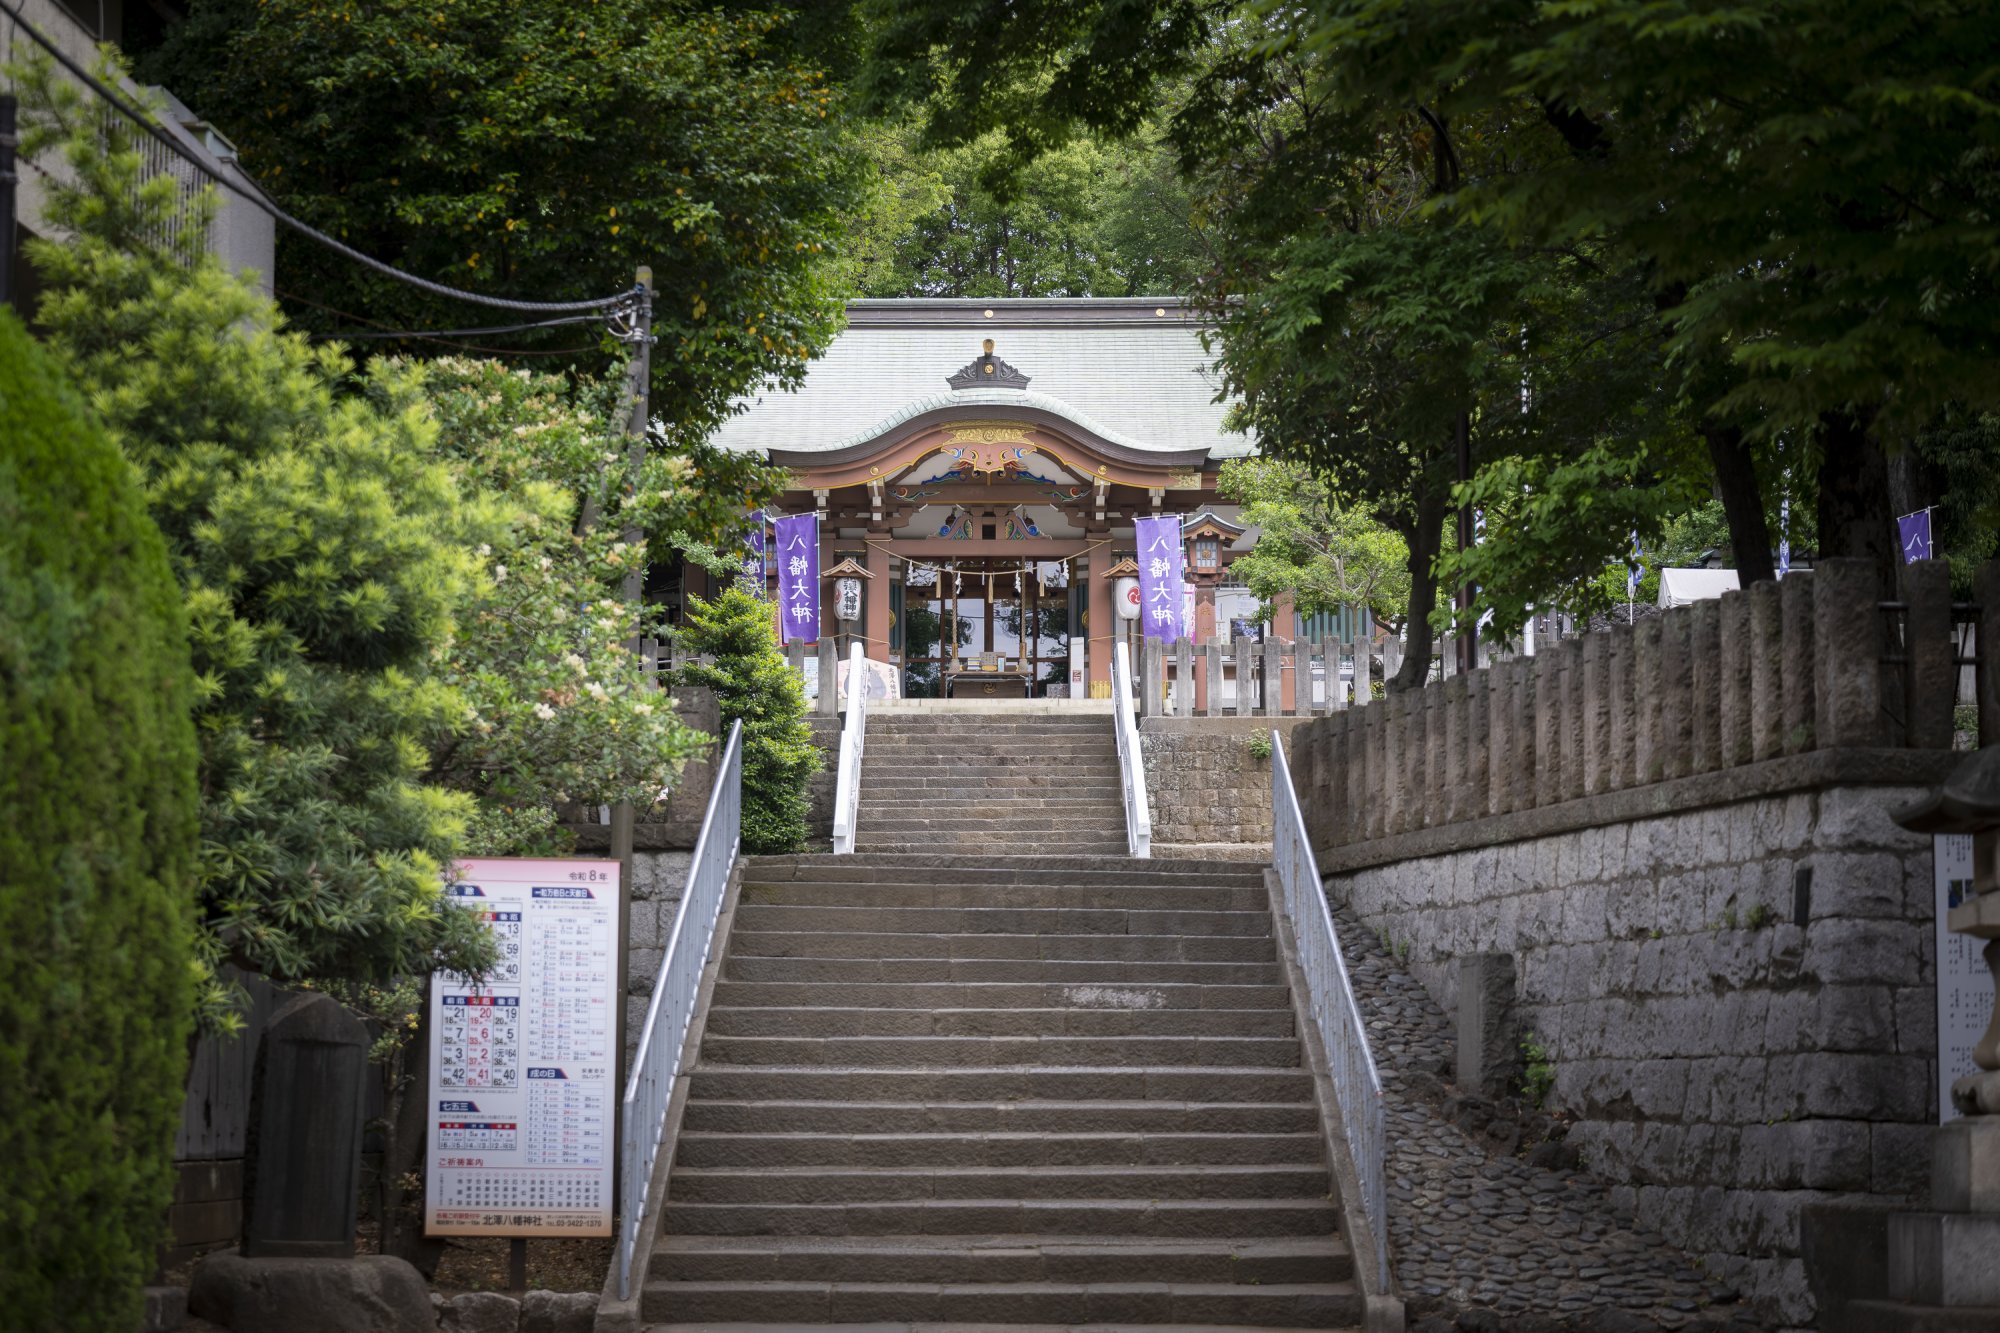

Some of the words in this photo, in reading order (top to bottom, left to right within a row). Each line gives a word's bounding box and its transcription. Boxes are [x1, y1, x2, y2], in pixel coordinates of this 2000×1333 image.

[508, 924, 519, 934] 13
[507, 944, 519, 954] 59
[506, 964, 518, 974] 40
[454, 1007, 465, 1018] 21
[480, 1008, 491, 1018] 20
[505, 1008, 517, 1019] 19
[456, 1027, 463, 1038] 7
[481, 1028, 489, 1039] 6
[507, 1028, 514, 1039] 5
[455, 1048, 463, 1059] 3
[481, 1048, 488, 1059] 2
[452, 1068, 465, 1079] 42
[478, 1069, 488, 1079] 41
[503, 1069, 516, 1080] 40
[442, 1102, 469, 1111] 七五三
[482, 1214, 543, 1226] 北澤八幡神社
